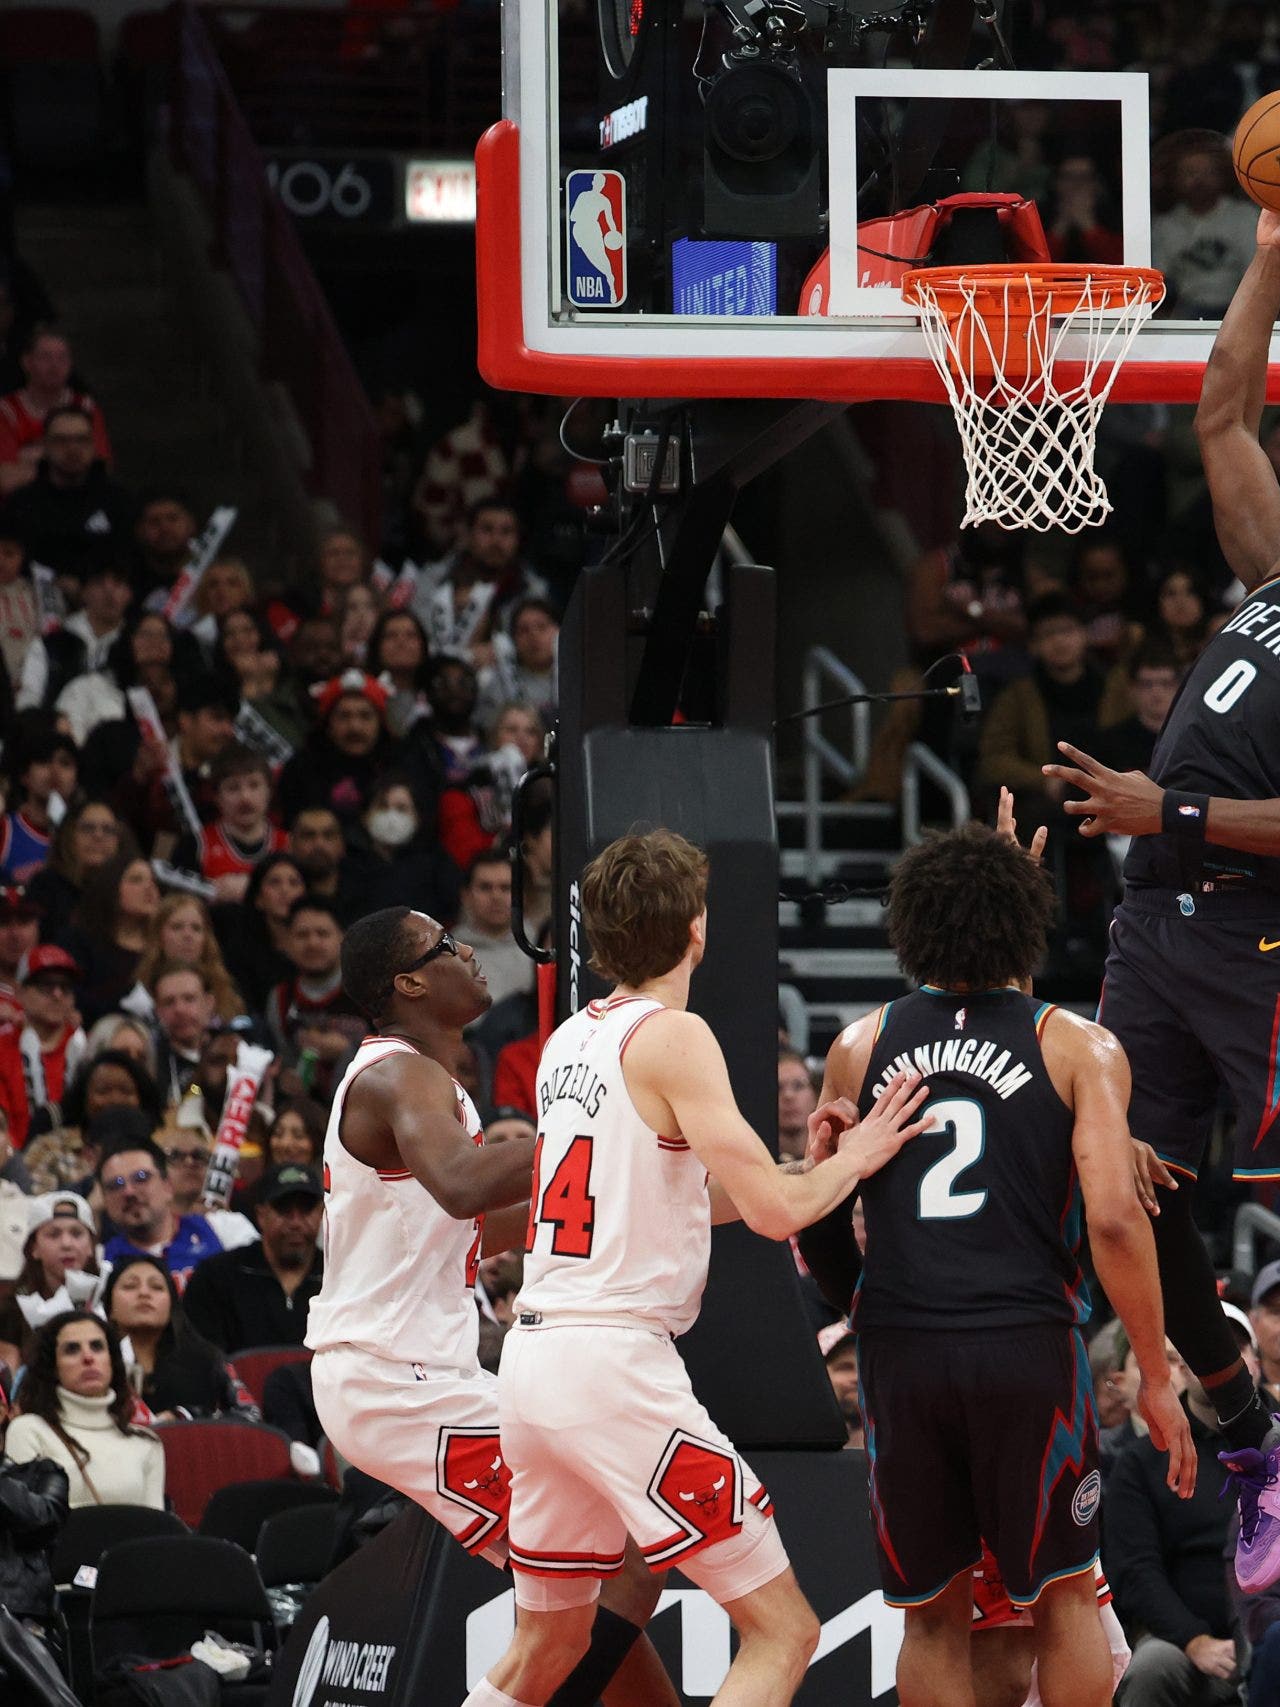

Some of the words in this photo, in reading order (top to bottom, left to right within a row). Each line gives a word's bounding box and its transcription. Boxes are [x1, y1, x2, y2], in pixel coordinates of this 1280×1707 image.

[576, 276, 604, 298] NBA
[680, 265, 748, 315] UNITED
[1203, 659, 1257, 714] 0
[540, 1063, 607, 1118] BUZELIS
[916, 1097, 988, 1220] 2
[321, 1639, 359, 1688] WIND
[353, 1643, 396, 1692] CREEK
